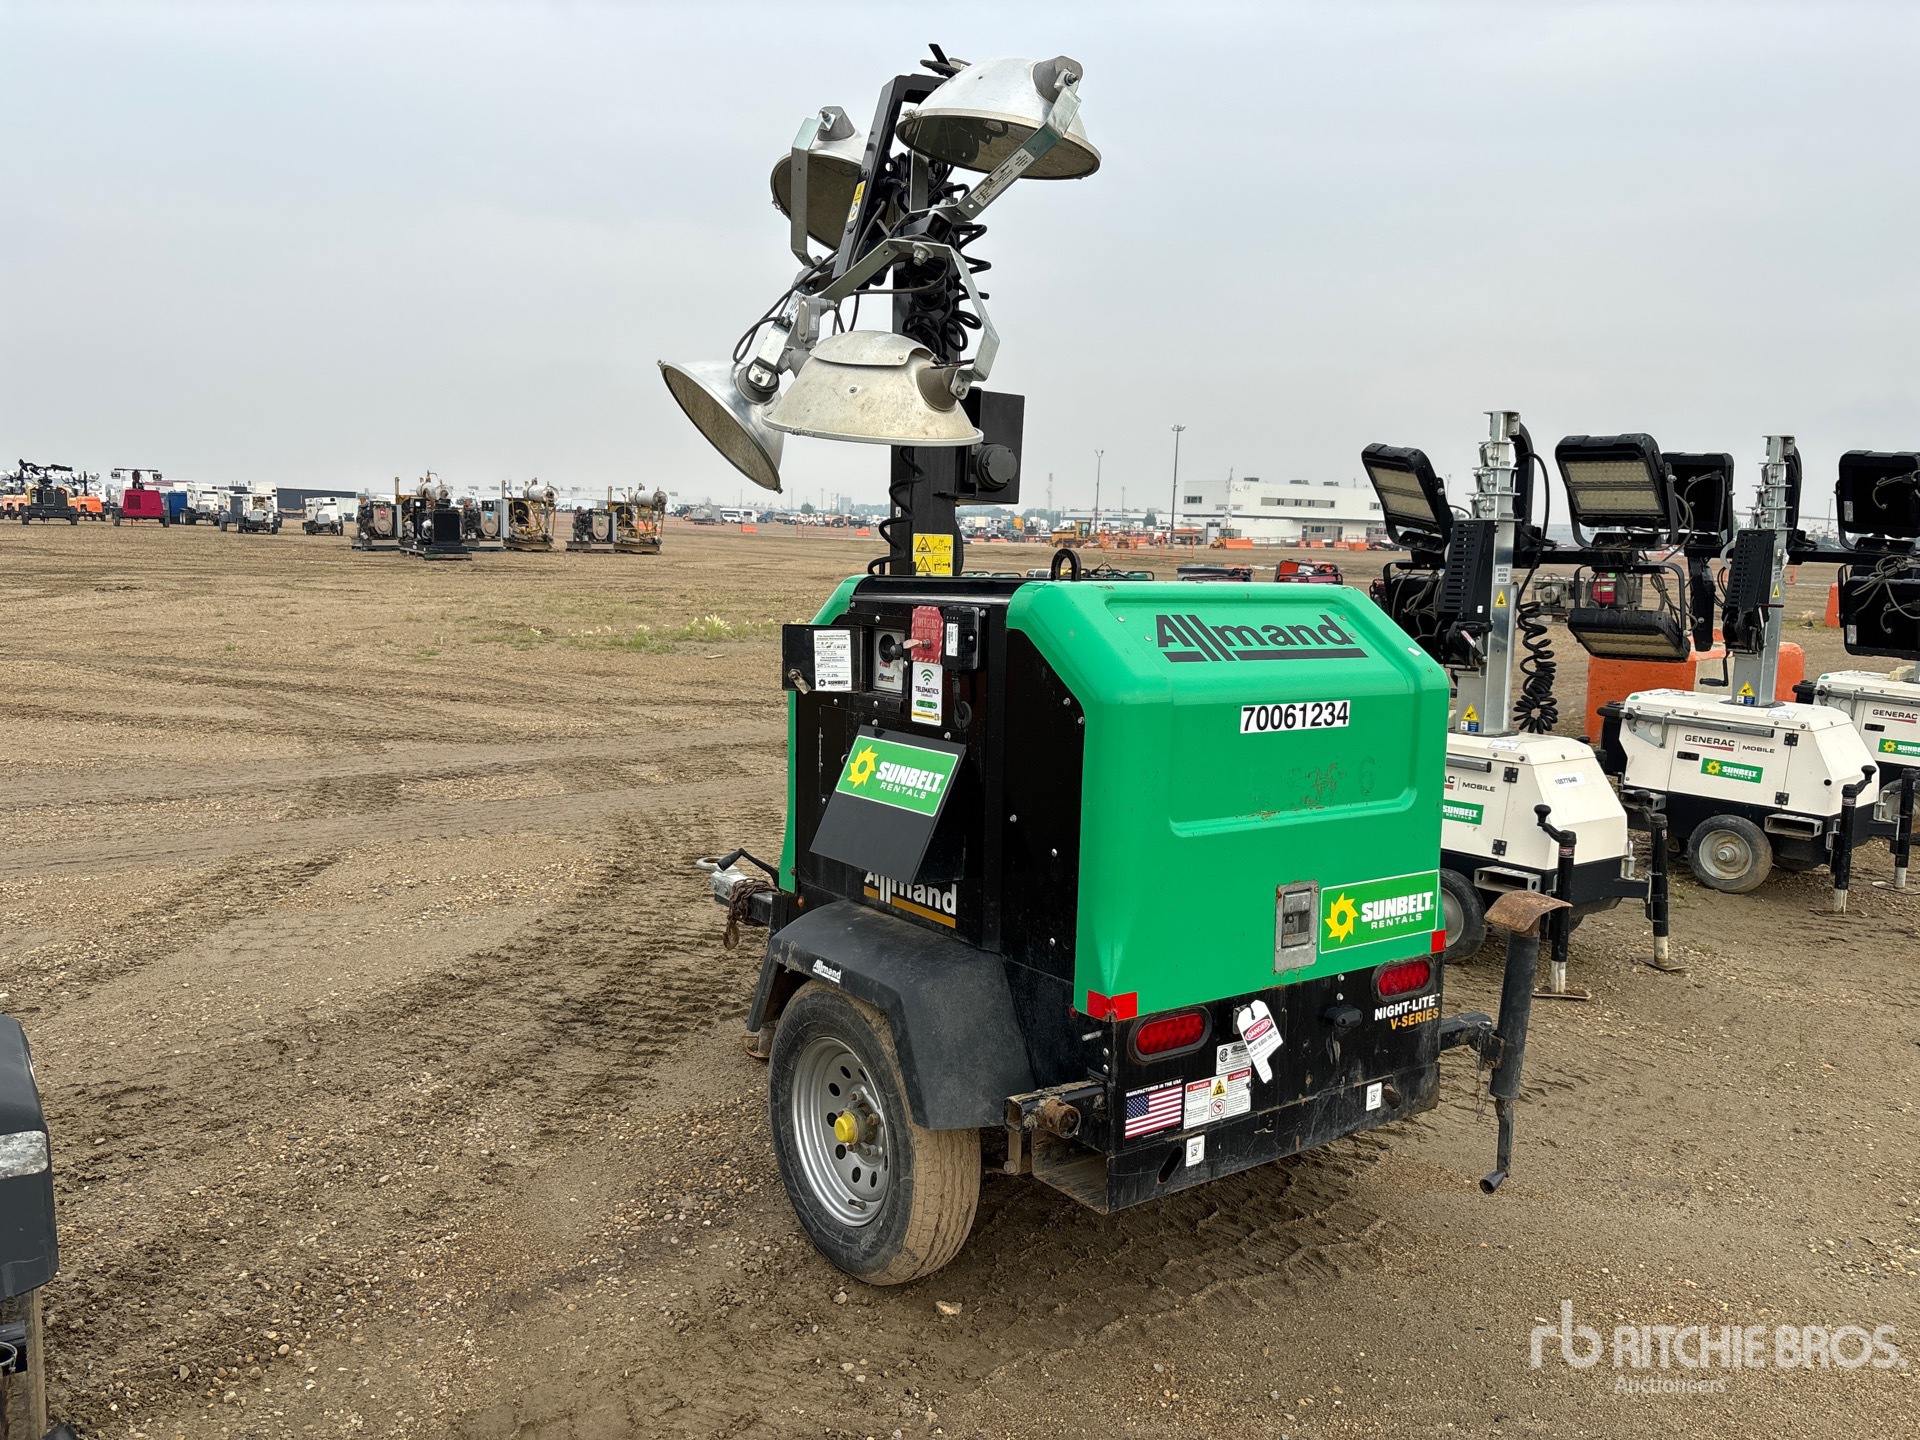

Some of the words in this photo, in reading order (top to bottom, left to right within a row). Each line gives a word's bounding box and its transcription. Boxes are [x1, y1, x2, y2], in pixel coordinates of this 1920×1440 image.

[1155, 614, 1357, 662] Allmand
[915, 685, 939, 695] TELEMATICS
[1242, 701, 1349, 732] 70061234
[1872, 708, 1918, 720] GENERAC
[1684, 734, 1735, 747] GENERAC
[1742, 744, 1775, 754] MOBILE
[875, 761, 945, 793] SUNBELT
[1721, 765, 1758, 778] SUNBELT
[1725, 772, 1752, 780] RENTALS
[880, 781, 927, 800] RENTALS
[1461, 781, 1496, 793] MOBILE
[1442, 806, 1478, 818] SUNBELT
[1445, 813, 1472, 821] RENTALS
[1361, 891, 1434, 923] SUNBELT
[1371, 913, 1423, 930] RENTALS
[812, 959, 842, 982] Allmand
[1390, 1007, 1439, 1030] V-SERIES
[1247, 1020, 1270, 1039] DANGER
[1232, 1071, 1250, 1080] DANGER
[1125, 1084, 1159, 1098] MANUFACTURED
[1164, 1080, 1173, 1088] THE
[1192, 1081, 1210, 1091] DANGER
